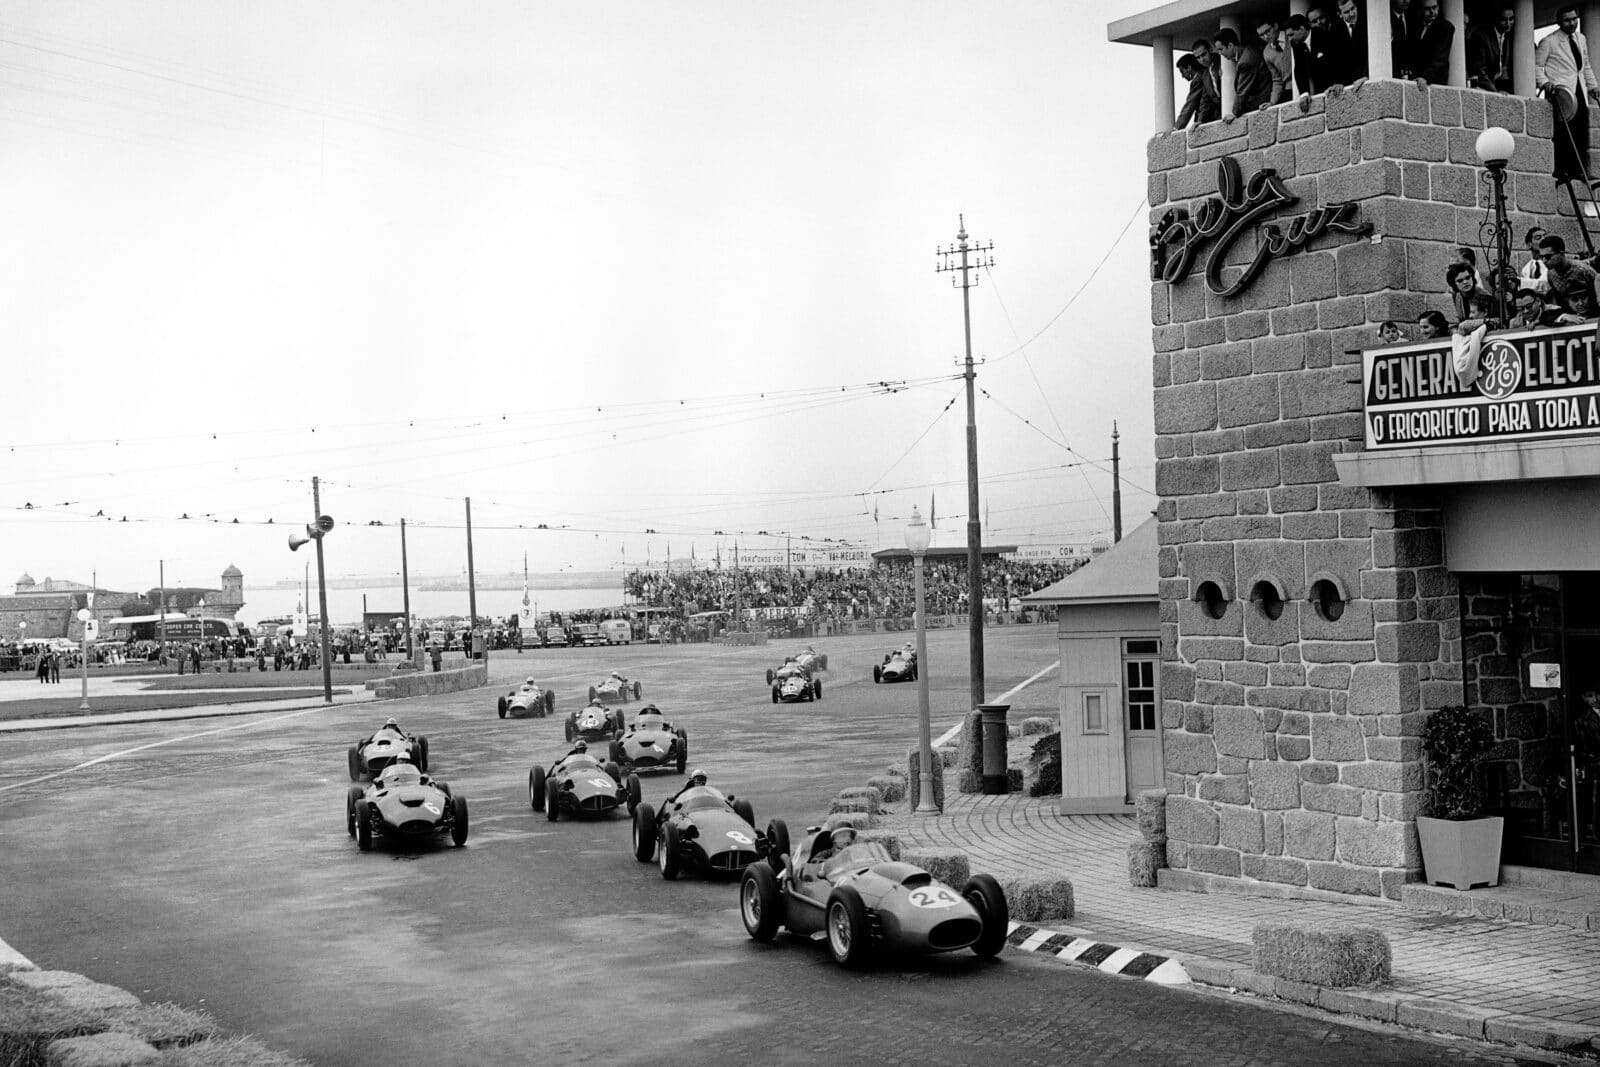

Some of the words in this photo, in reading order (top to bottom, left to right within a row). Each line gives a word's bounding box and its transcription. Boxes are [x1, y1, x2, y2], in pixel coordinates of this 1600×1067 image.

[1205, 199, 1375, 297] Cruz
[1524, 335, 1600, 387] ELECT
[1389, 407, 1480, 441] FRIGORIFICO
[1488, 401, 1531, 433] PARA
[1536, 396, 1582, 428] TODA
[1587, 395, 1600, 425] A
[1059, 547, 1074, 556] COM
[587, 778, 612, 788] 10
[424, 802, 441, 815] 6
[726, 830, 753, 844] 8
[912, 891, 956, 906] 24
